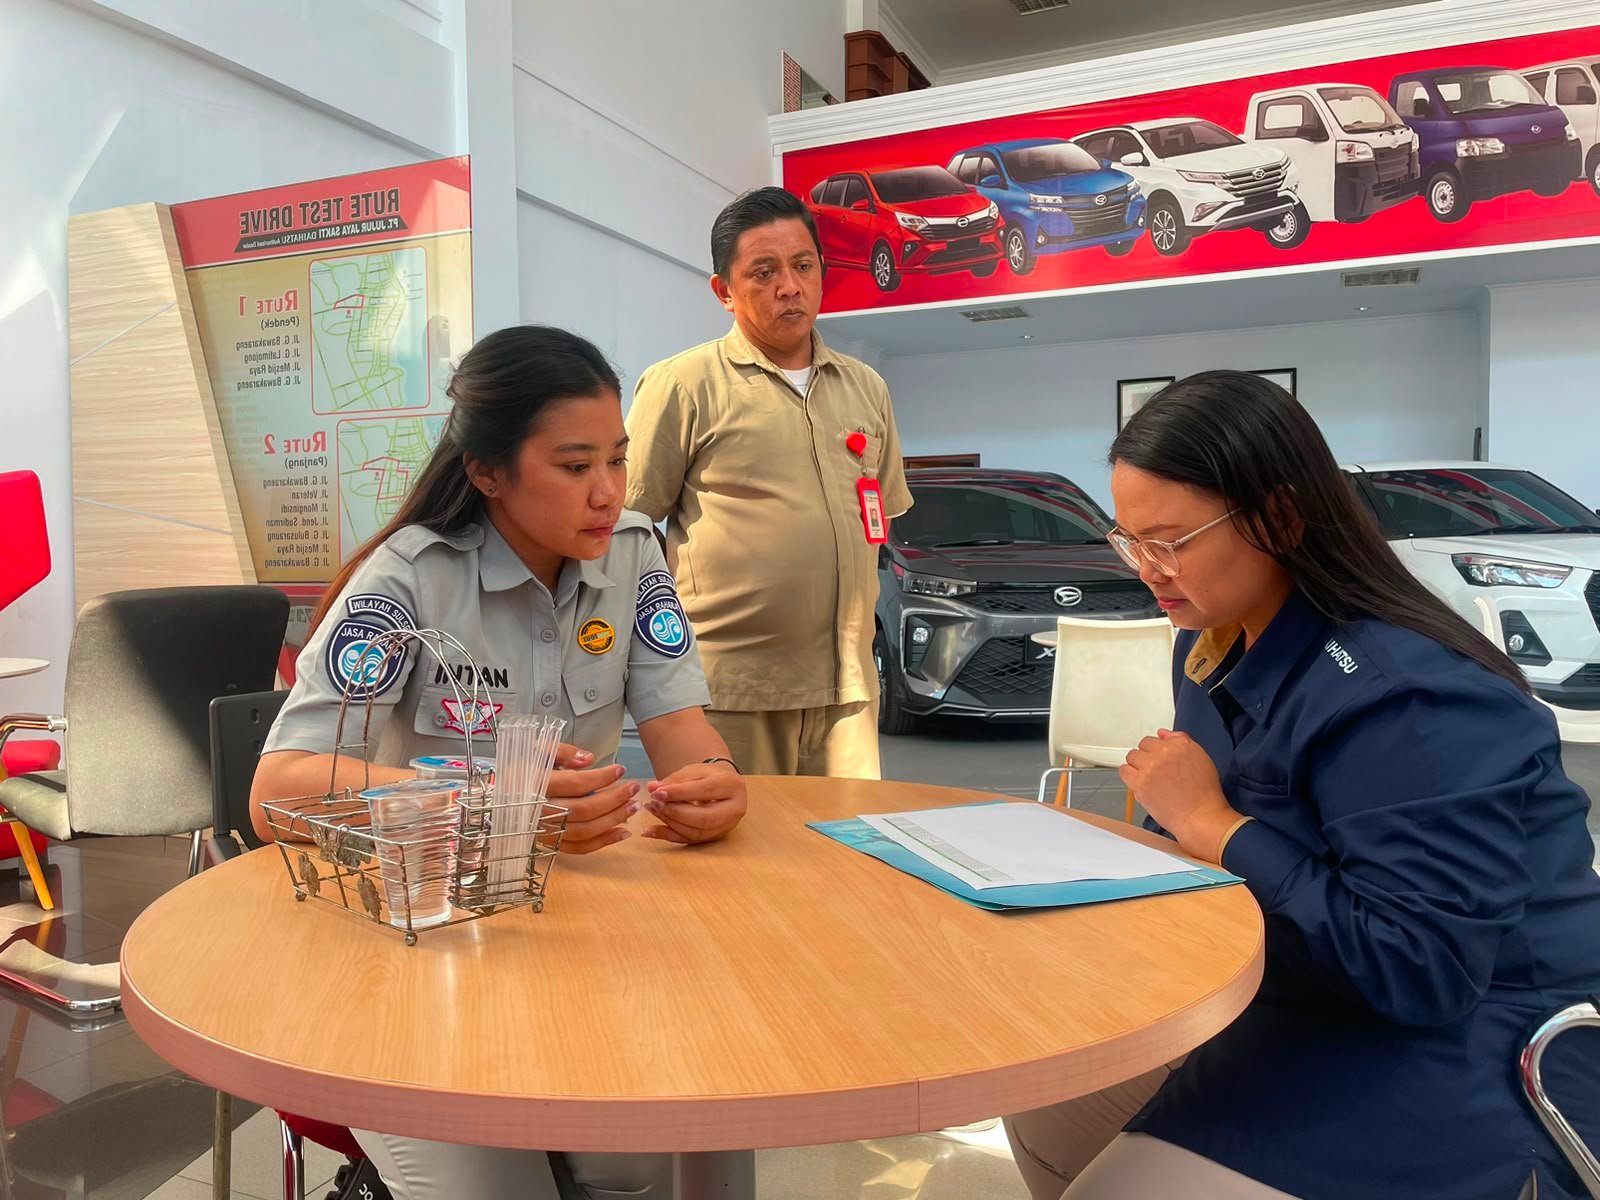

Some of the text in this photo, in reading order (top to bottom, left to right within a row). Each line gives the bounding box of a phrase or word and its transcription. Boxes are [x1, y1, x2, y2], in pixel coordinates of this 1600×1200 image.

[353, 600, 391, 613] WILAYAH
[638, 606, 656, 620] JASA
[341, 627, 364, 639] JASA
[434, 663, 509, 688] INTAN
